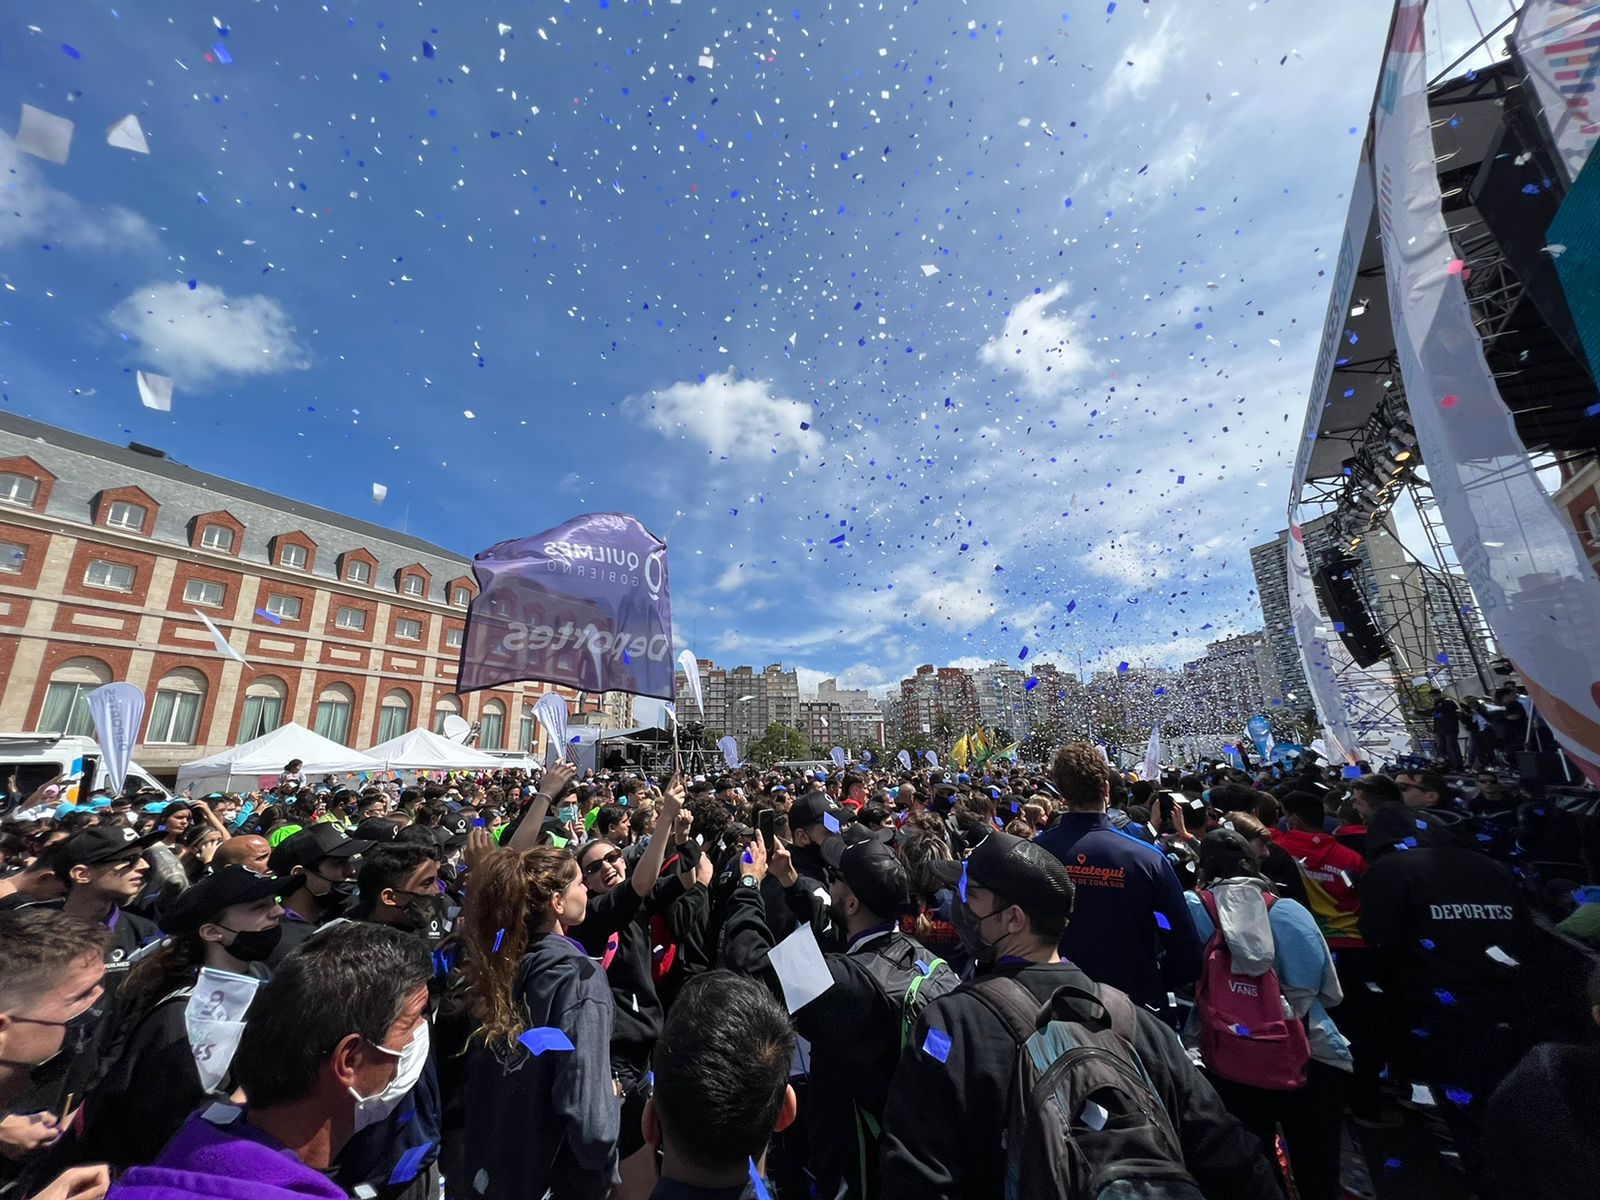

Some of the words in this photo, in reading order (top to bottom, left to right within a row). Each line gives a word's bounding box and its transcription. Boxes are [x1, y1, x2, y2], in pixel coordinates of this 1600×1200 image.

[1110, 881, 1125, 889] SUR
[1430, 903, 1513, 920] DEPORTES
[1228, 979, 1258, 997] VANS
